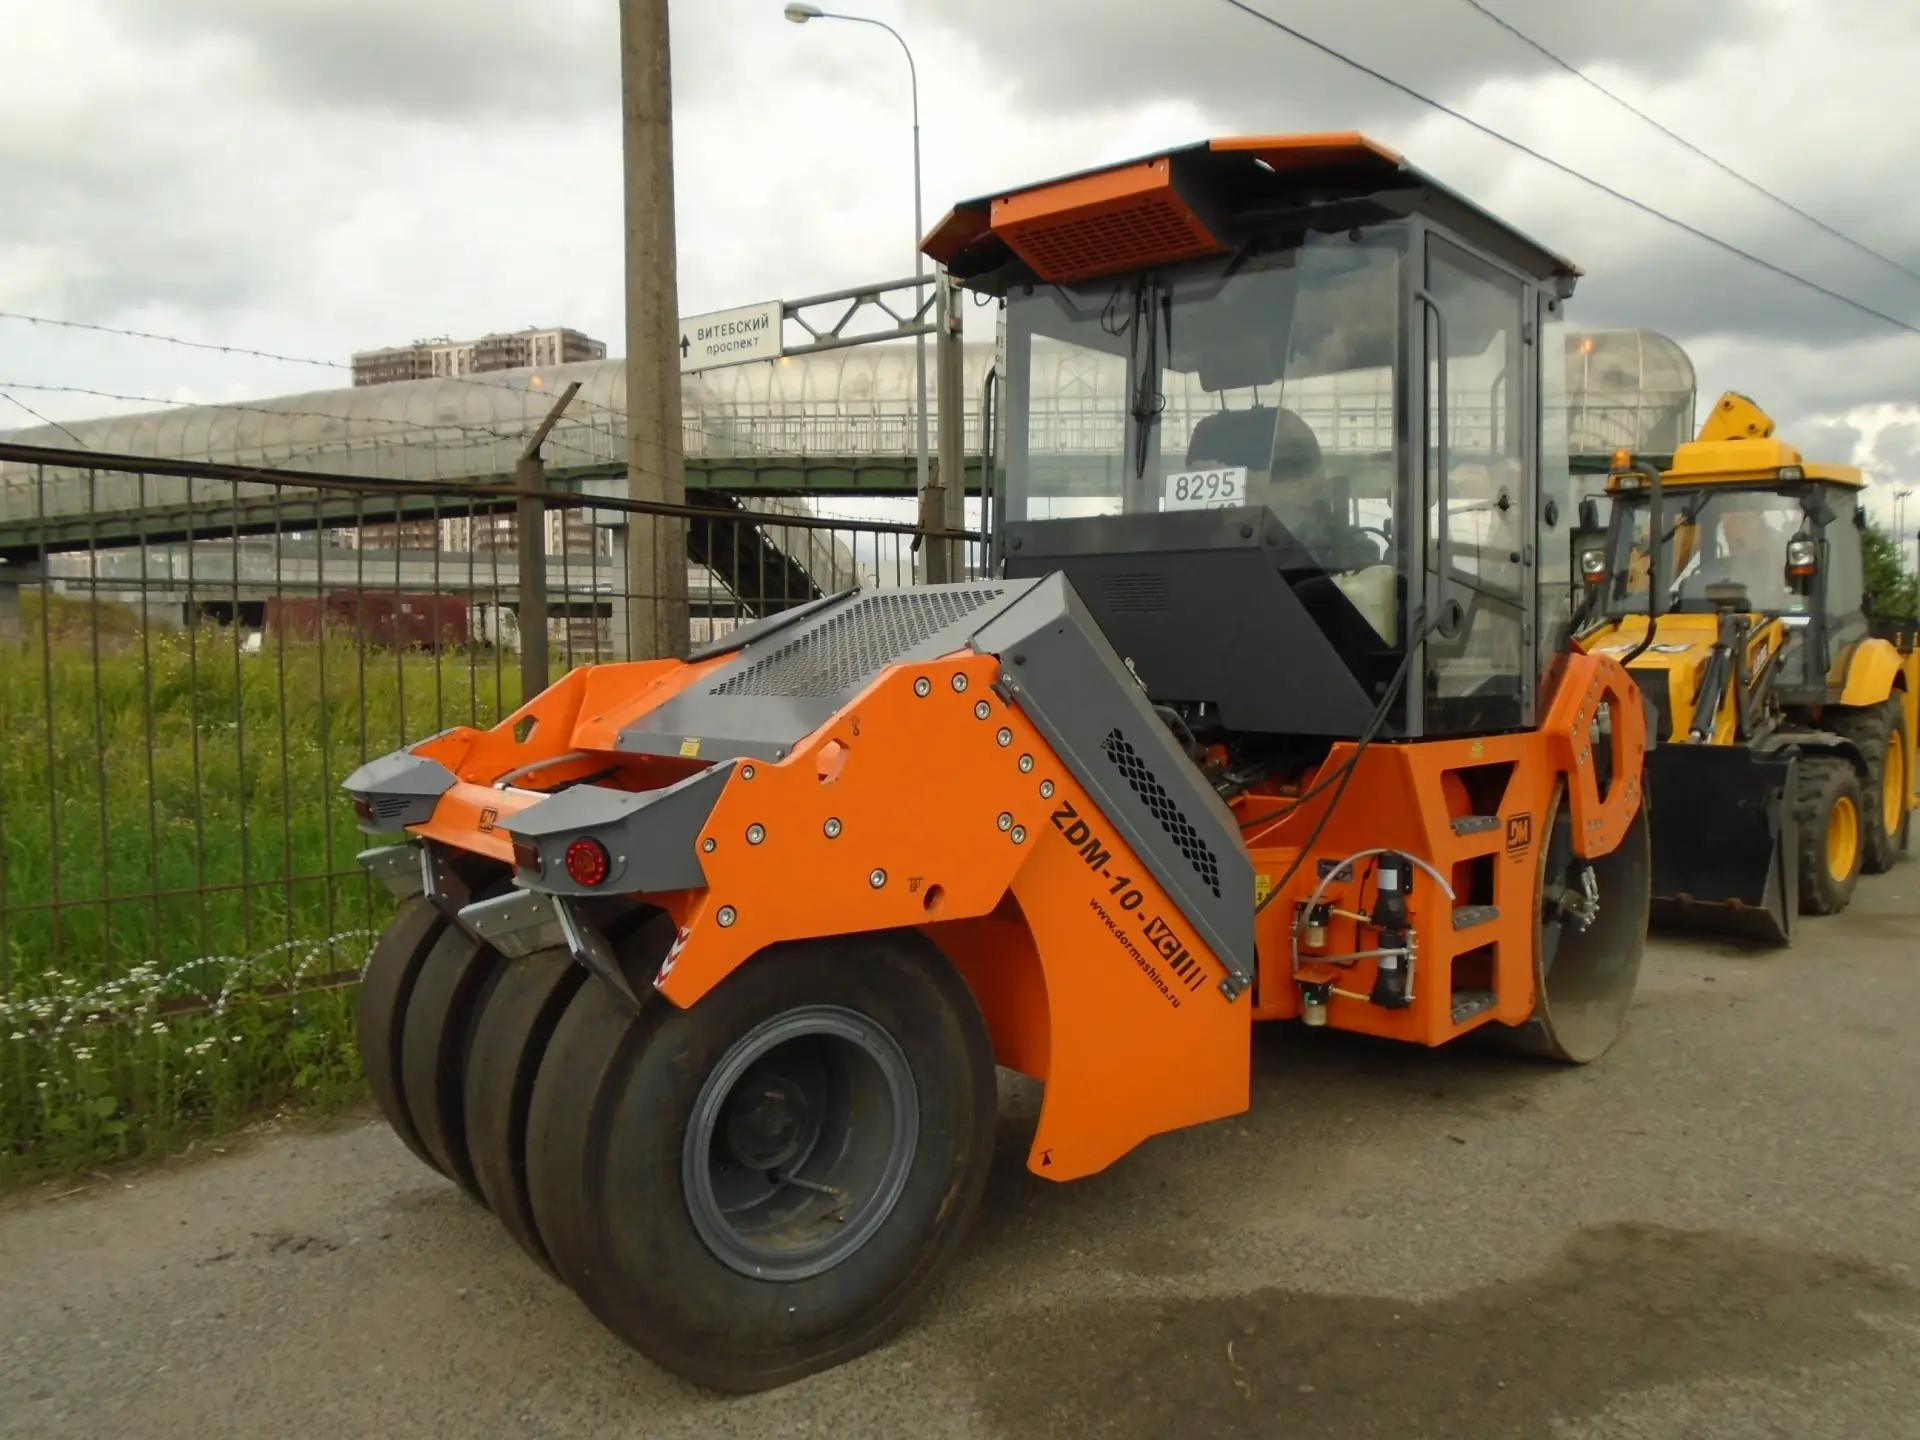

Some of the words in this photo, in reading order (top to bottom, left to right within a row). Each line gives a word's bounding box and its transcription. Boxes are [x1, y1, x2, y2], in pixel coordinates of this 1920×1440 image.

[697, 313, 769, 340] ВИТЕБСКИЙ
[706, 337, 760, 356] проспект
[1175, 471, 1235, 501] 8295
[1089, 898, 1181, 1008] www.dormashina.ru
